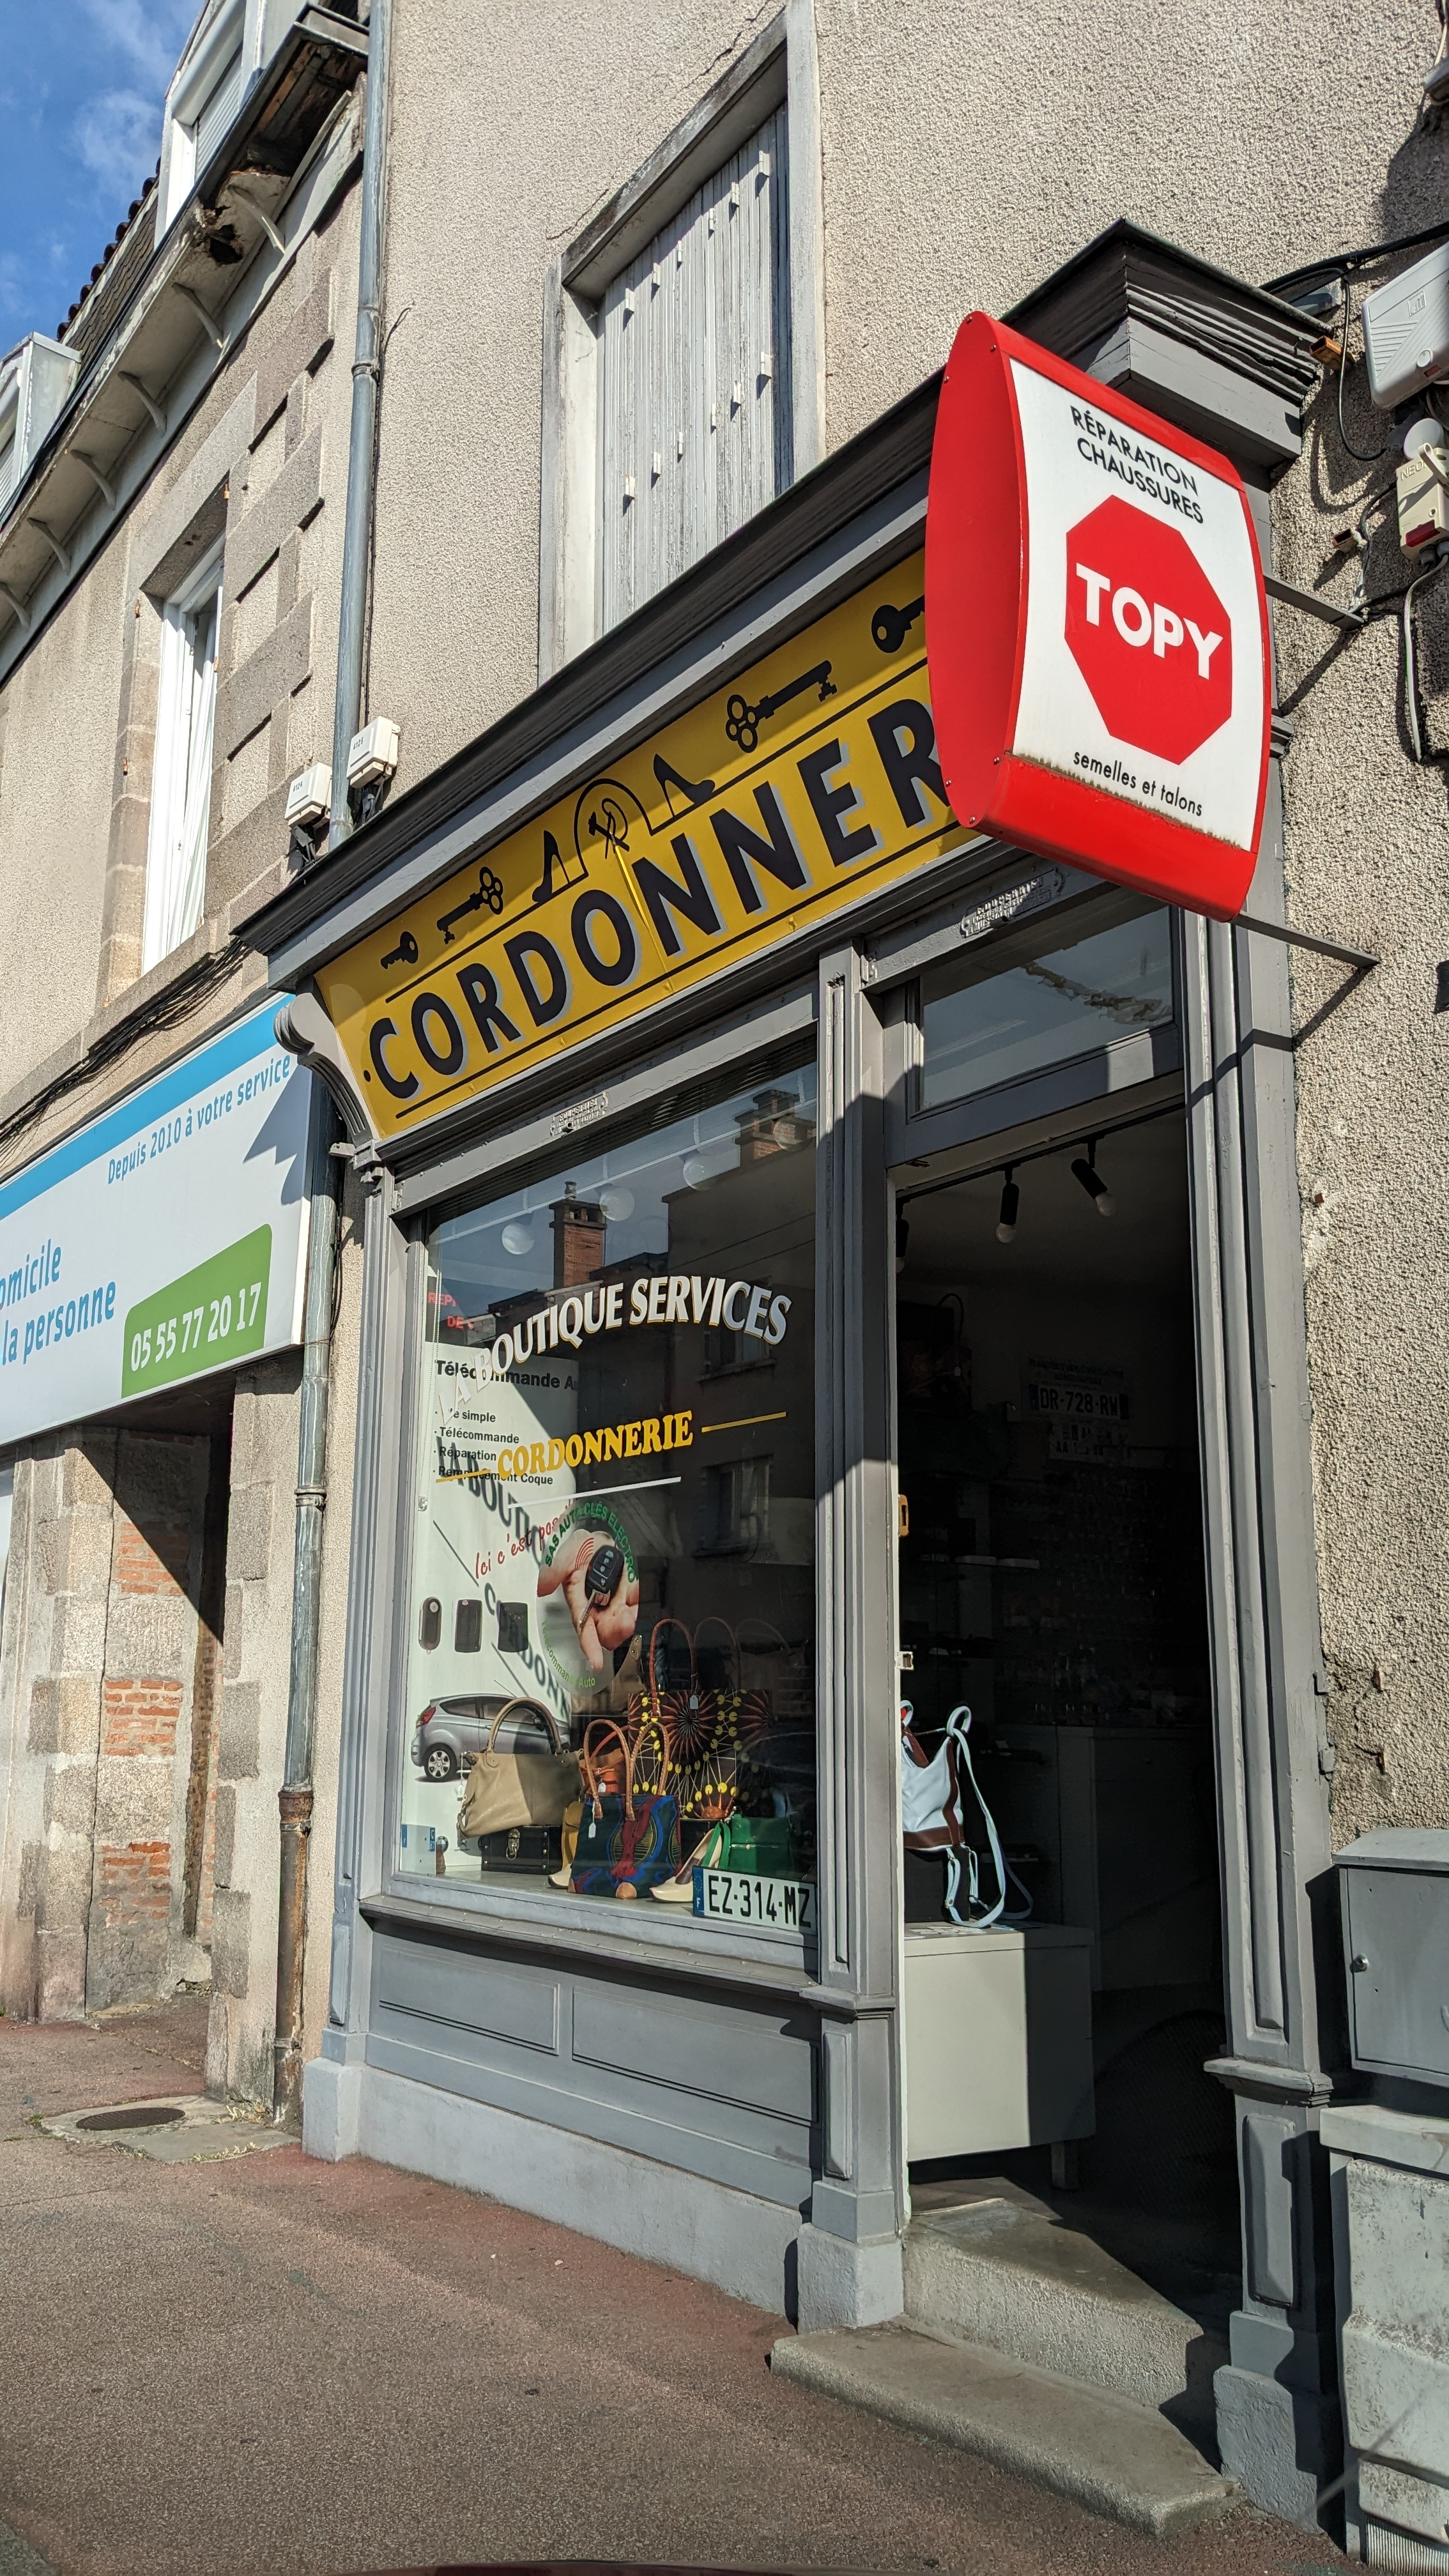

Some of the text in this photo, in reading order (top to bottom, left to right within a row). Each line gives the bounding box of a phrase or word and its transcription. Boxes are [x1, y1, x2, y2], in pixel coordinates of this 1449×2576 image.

[1070, 405, 1199, 497] RÉPARATION
[1077, 438, 1204, 524] CHAUSSURES
[1075, 563, 1224, 681] TOPY
[1073, 751, 1202, 816] semelles et talons
[108, 1055, 291, 1184] Depuis 2010 à votre service
[2, 1281, 116, 1365] la personne
[131, 1282, 261, 1372] 05 55 77 20 17
[473, 1282, 624, 1393] BOUTIQUE
[629, 1275, 792, 1346] SERVICES
[439, 1426, 519, 1444] Télécommande
[462, 1410, 496, 1424] simple
[497, 1409, 694, 1480] CORDONNERIE
[439, 1446, 496, 1462] Réparation
[520, 1475, 553, 1486] Coque
[584, 1501, 608, 1521] CLÉS
[475, 1527, 532, 1579] Ici c'est
[578, 1677, 595, 1687] Auto
